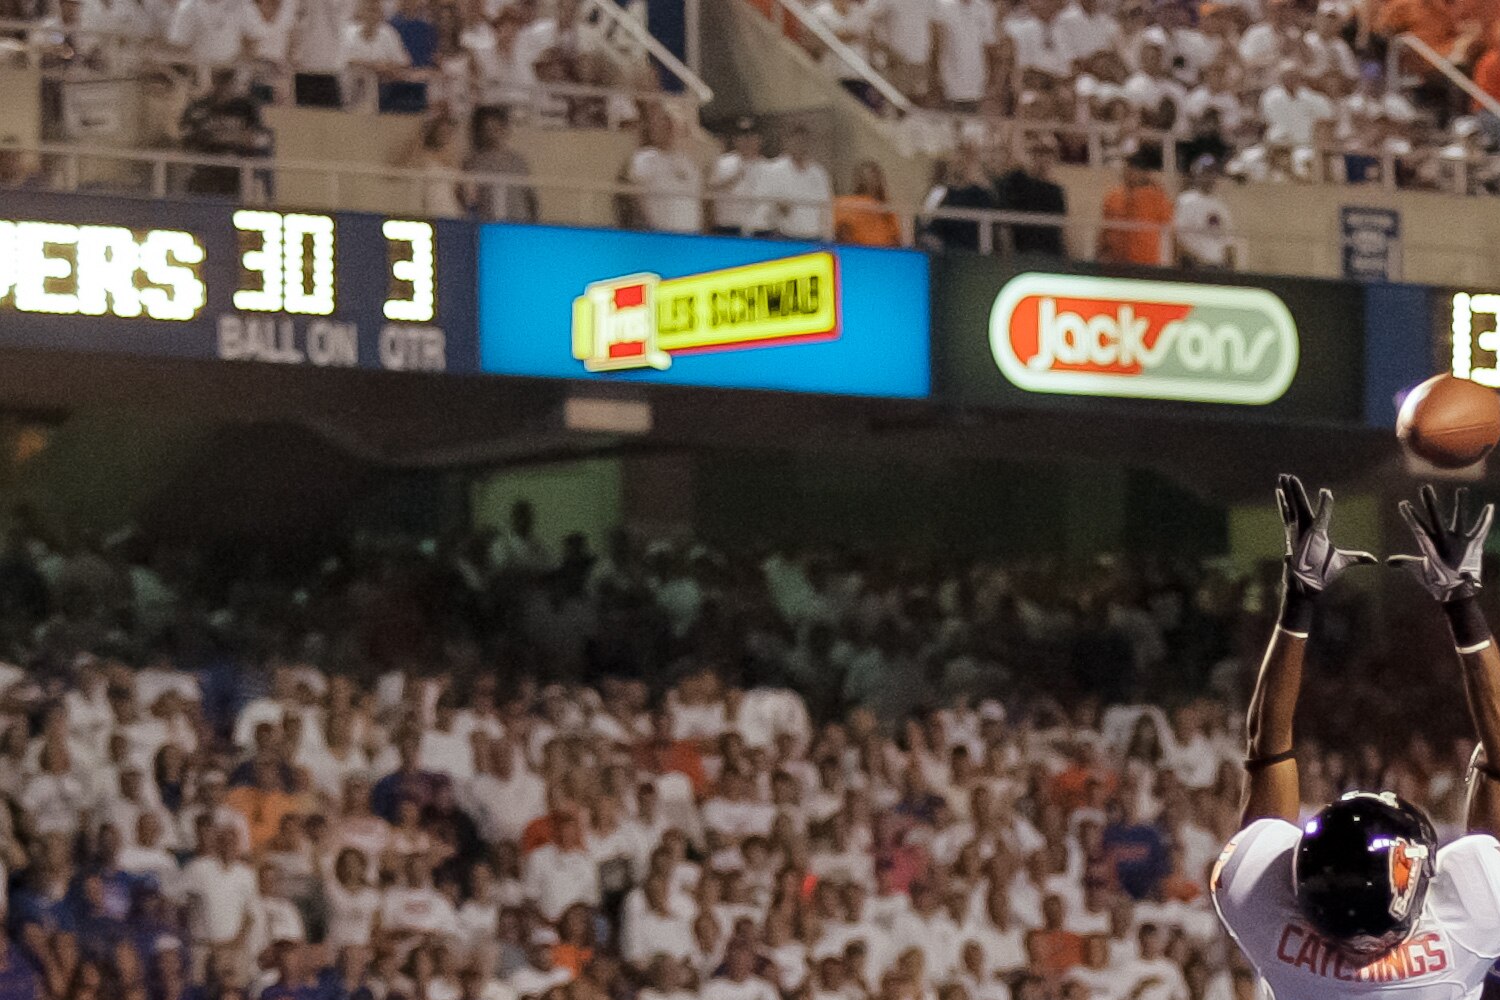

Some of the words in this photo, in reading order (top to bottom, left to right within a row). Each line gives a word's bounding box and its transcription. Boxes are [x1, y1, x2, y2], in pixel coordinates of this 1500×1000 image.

[232, 211, 335, 314] 30
[382, 220, 434, 322] 3
[217, 315, 304, 363] BALL
[306, 319, 358, 368] ON
